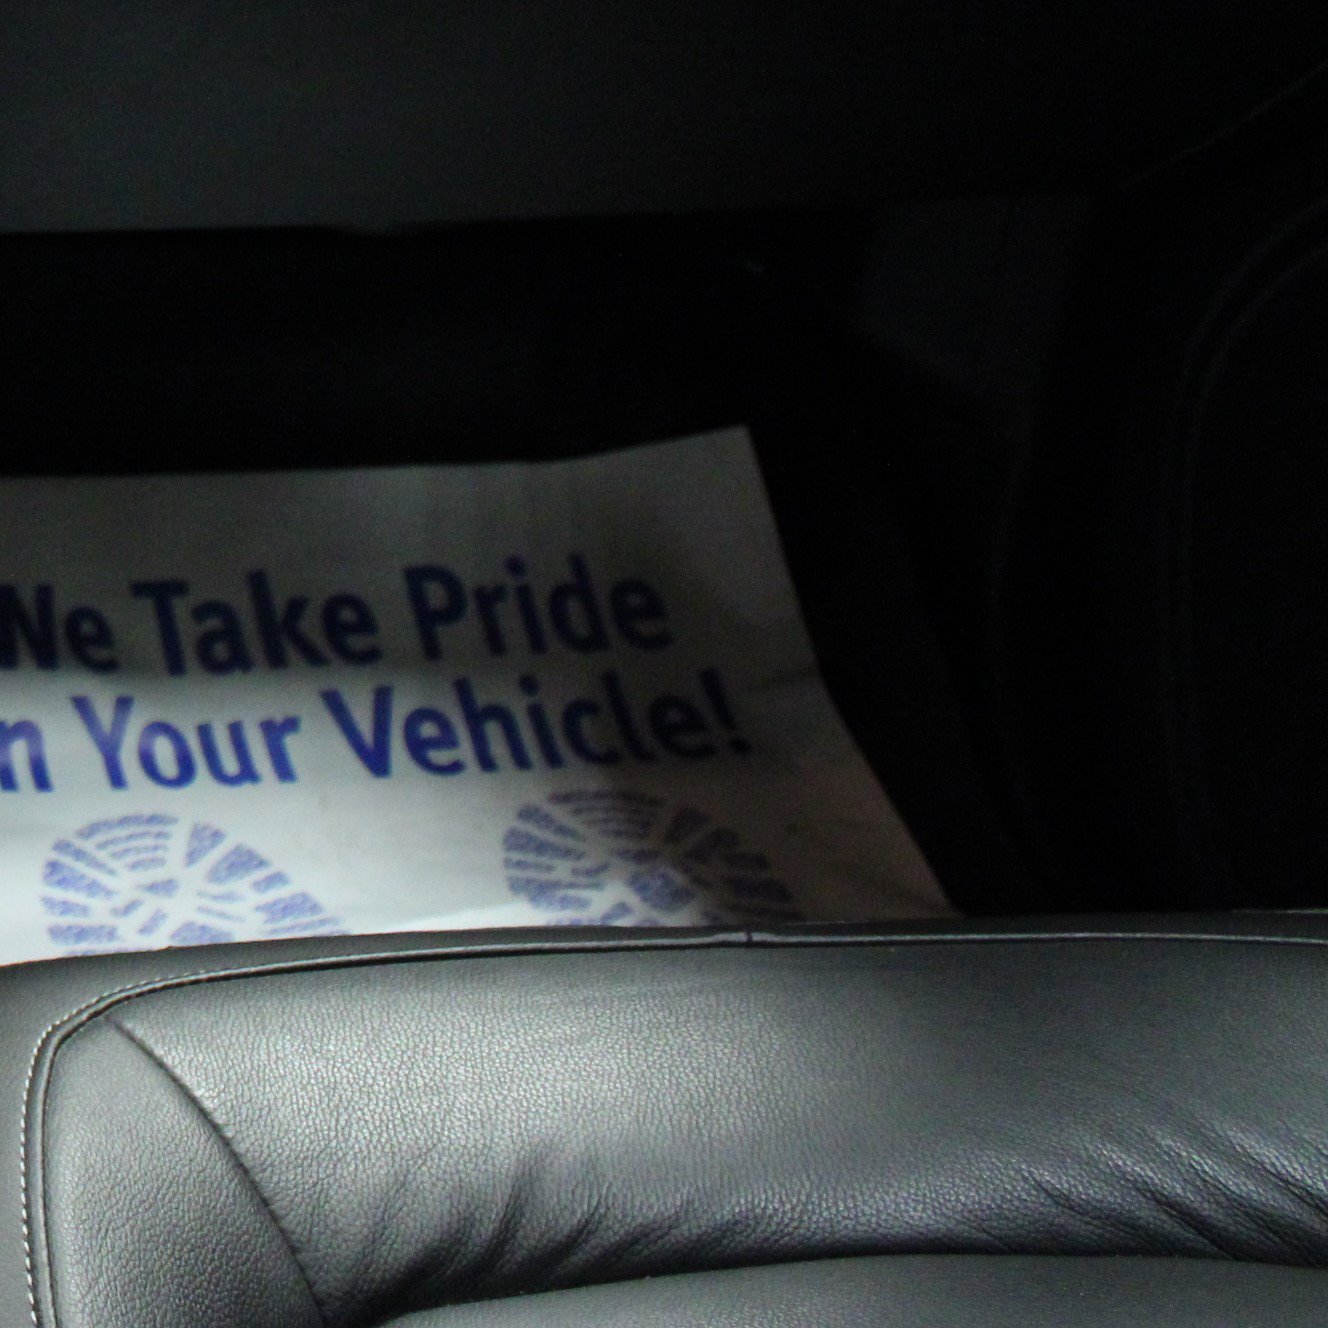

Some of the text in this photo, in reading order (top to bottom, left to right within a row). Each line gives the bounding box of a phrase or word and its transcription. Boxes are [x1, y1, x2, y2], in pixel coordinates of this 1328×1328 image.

[129, 570, 384, 676] Take
[404, 552, 673, 662] Pride
[70, 694, 302, 791] Your
[318, 667, 753, 780] Vehicle!
